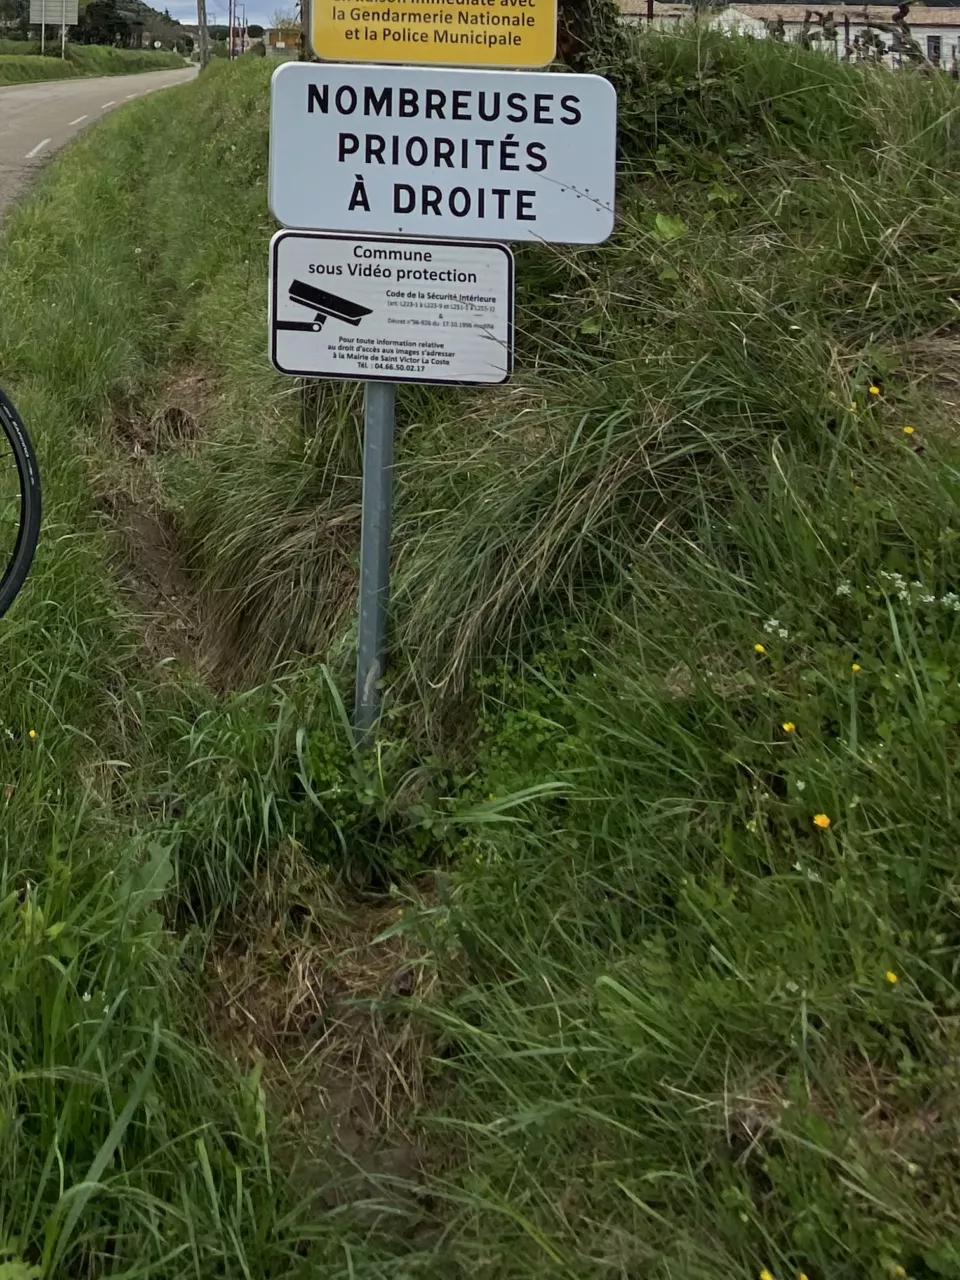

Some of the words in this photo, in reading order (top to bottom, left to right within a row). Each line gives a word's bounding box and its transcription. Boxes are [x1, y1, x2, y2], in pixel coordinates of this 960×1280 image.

[332, 8, 345, 20] la
[350, 8, 453, 25] Gendarmerie
[458, 11, 535, 27] Nationale
[345, 28, 360, 39] et
[364, 26, 377, 40] la
[383, 28, 429, 43] Police
[433, 30, 522, 48] Municipale
[307, 83, 582, 125] NOMBREUSES
[338, 132, 548, 172] PRIORITÉS
[348, 174, 371, 212] À
[393, 183, 537, 221] DROITE
[353, 245, 432, 262] Commune
[308, 263, 343, 276] sous
[347, 263, 392, 278] Vidéo
[396, 268, 477, 284] protection
[386, 290, 405, 298] Code
[406, 291, 416, 299] de
[418, 291, 425, 299] la
[427, 291, 457, 300] Sécurité
[460, 294, 497, 303] Intérieure
[338, 336, 355, 344] Pour
[356, 337, 375, 345] toute
[376, 338, 417, 347] information
[418, 340, 444, 348] relative
[355, 345, 380, 353] d'accès
[395, 347, 420, 356] images
[346, 352, 368, 360] Mairie
[380, 354, 398, 362] Saint
[400, 356, 420, 364] Victor
